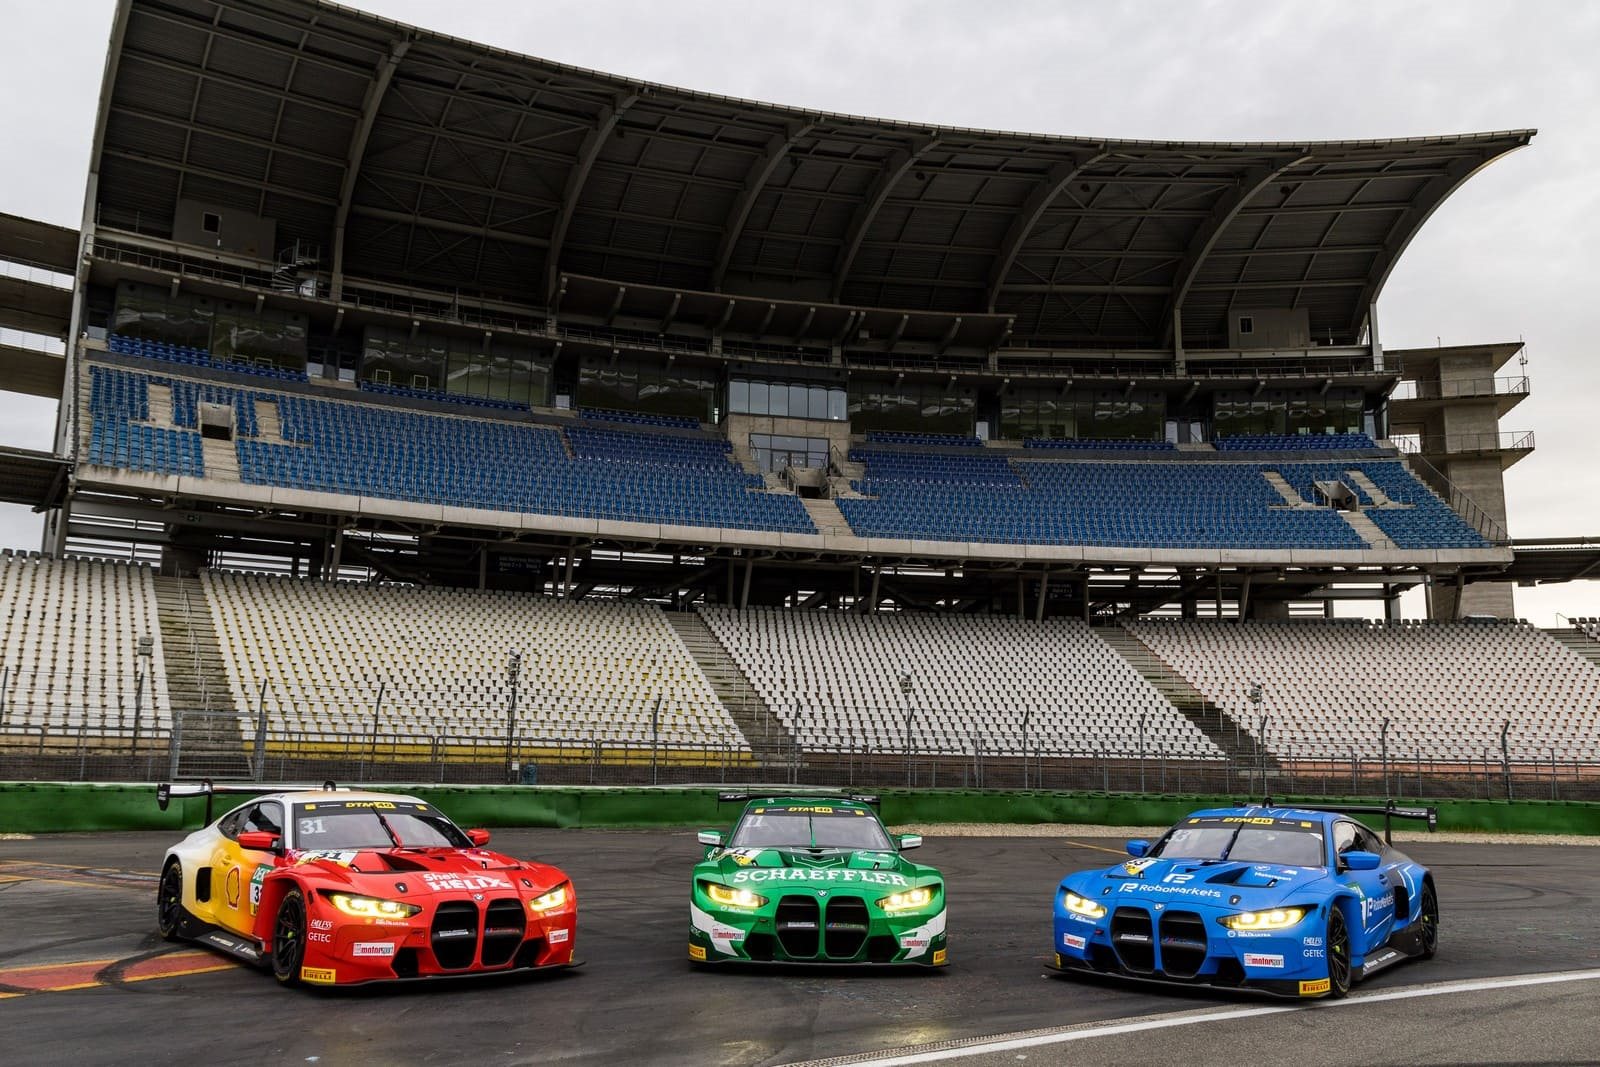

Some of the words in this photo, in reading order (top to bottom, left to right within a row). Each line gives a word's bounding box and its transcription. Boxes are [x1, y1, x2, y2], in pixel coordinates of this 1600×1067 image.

[300, 818, 327, 835] 31
[423, 872, 460, 881] Shell
[427, 874, 513, 891] HELIX
[733, 868, 908, 887] SCHAEFFLER
[308, 932, 332, 942] GETEC
[1303, 949, 1325, 958] GETEC
